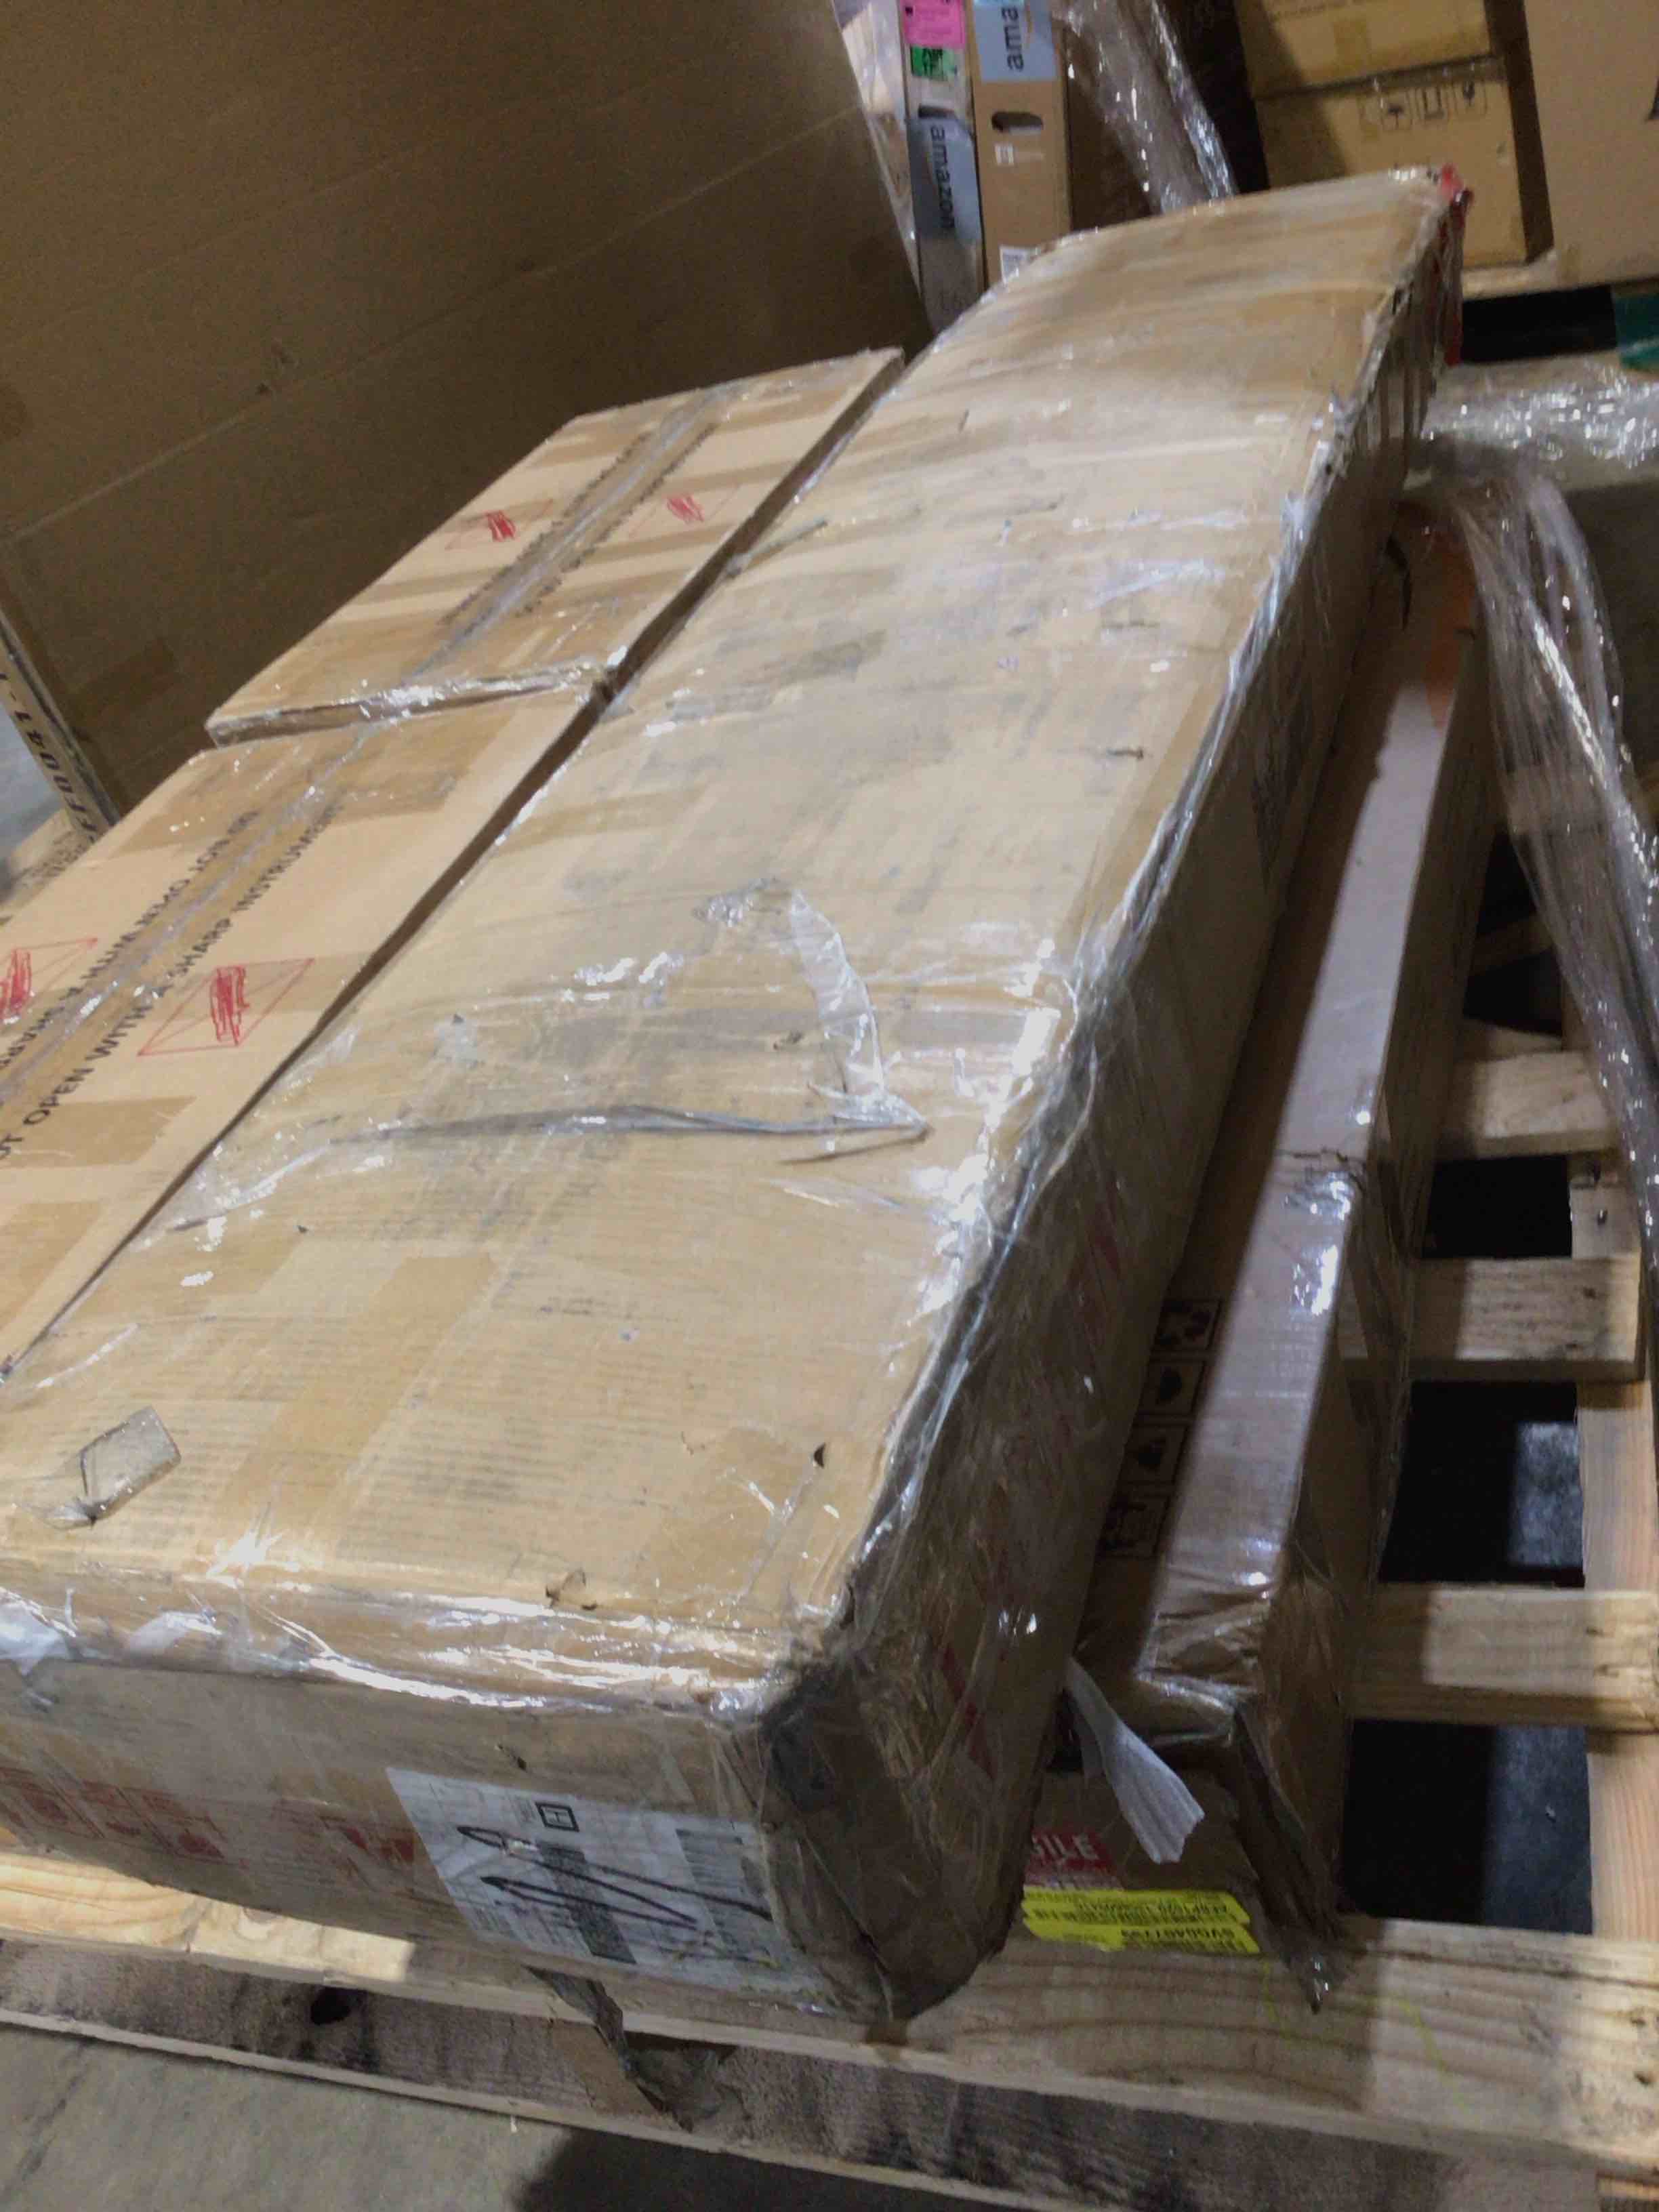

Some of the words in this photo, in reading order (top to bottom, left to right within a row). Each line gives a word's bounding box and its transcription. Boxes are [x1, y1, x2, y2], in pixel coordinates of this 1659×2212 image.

[930, 125, 954, 229] amazon
[23, 1066, 95, 1126] OPEN
[84, 1002, 154, 1062] WITH
[165, 917, 232, 978] SHARP
